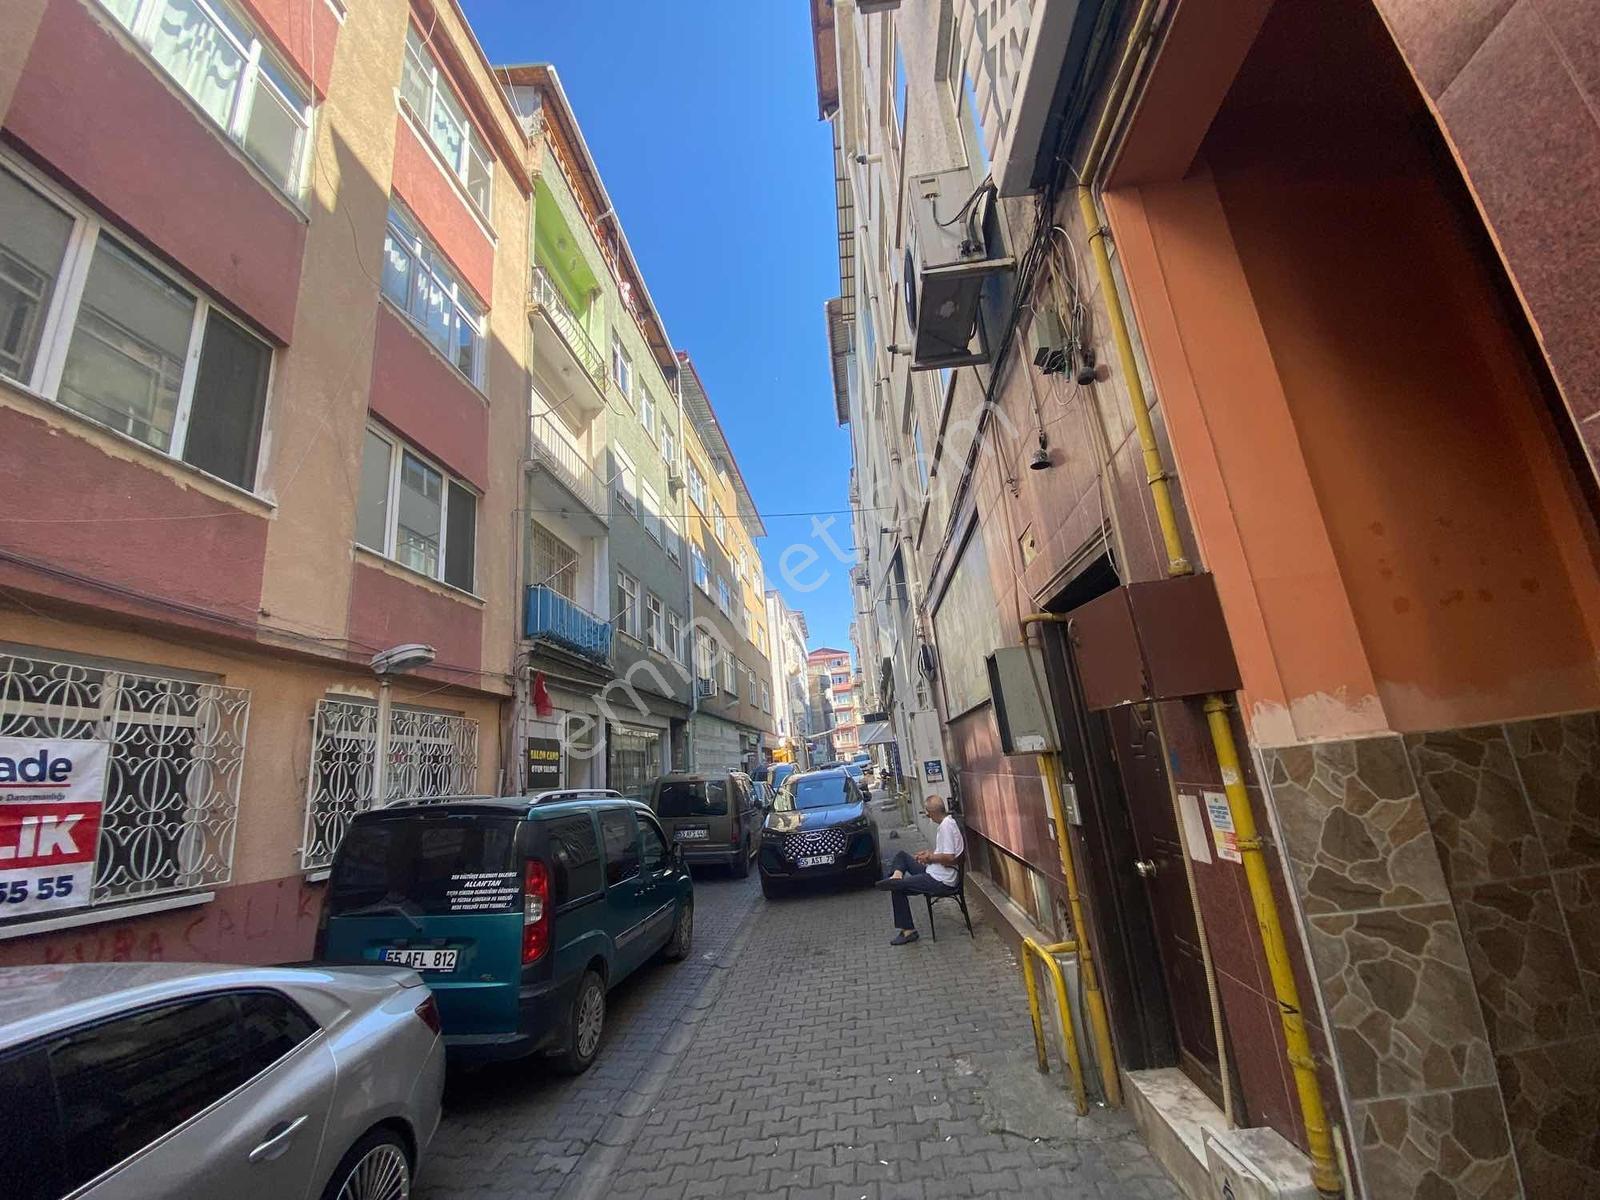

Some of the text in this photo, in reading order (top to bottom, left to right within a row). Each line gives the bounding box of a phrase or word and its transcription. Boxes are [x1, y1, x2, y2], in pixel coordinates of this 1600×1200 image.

[37, 874, 74, 901] 55
[405, 951, 427, 967] AFL
[433, 951, 456, 967] 812
